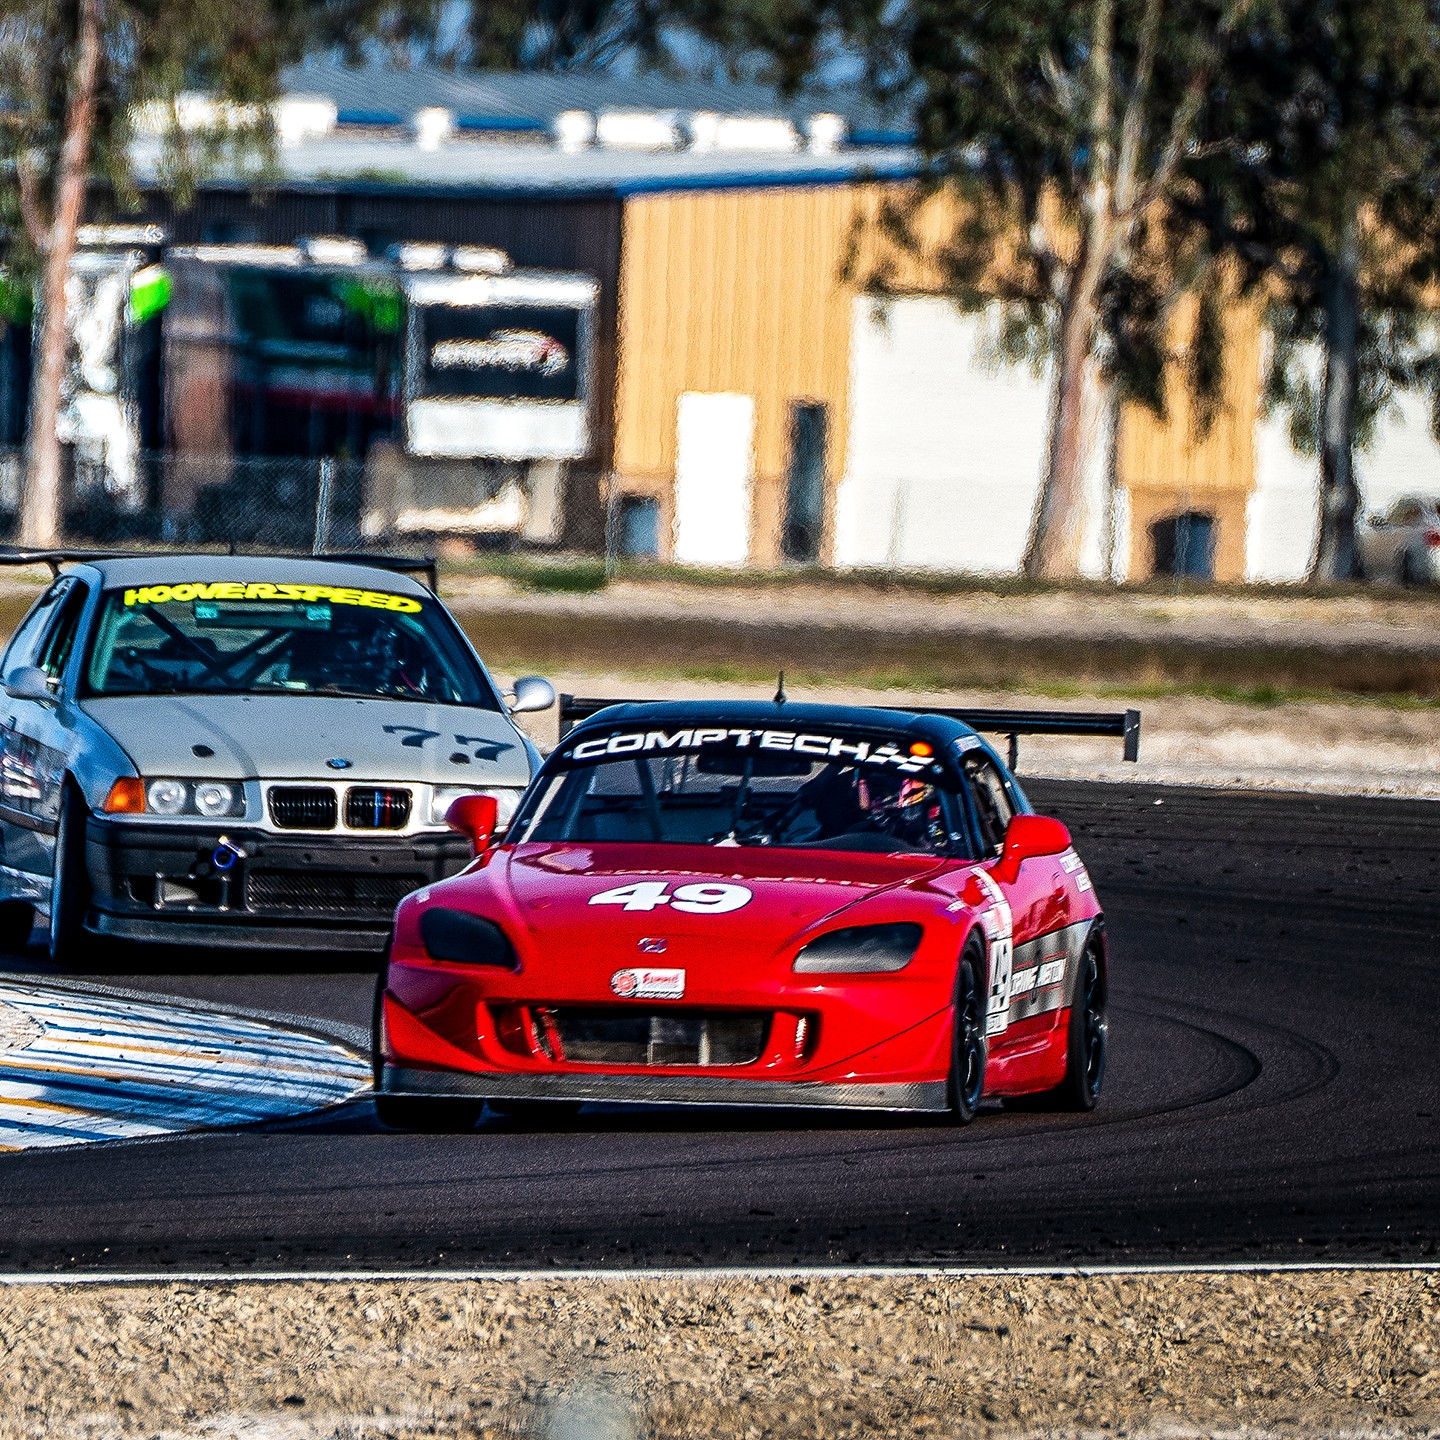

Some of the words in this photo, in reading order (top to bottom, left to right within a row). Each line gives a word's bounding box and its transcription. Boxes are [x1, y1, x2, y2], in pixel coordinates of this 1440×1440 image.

[124, 582, 423, 613] HOOVERSPEED
[382, 724, 517, 763] 77
[572, 729, 870, 760] COMPTECH
[588, 881, 753, 914] 49
